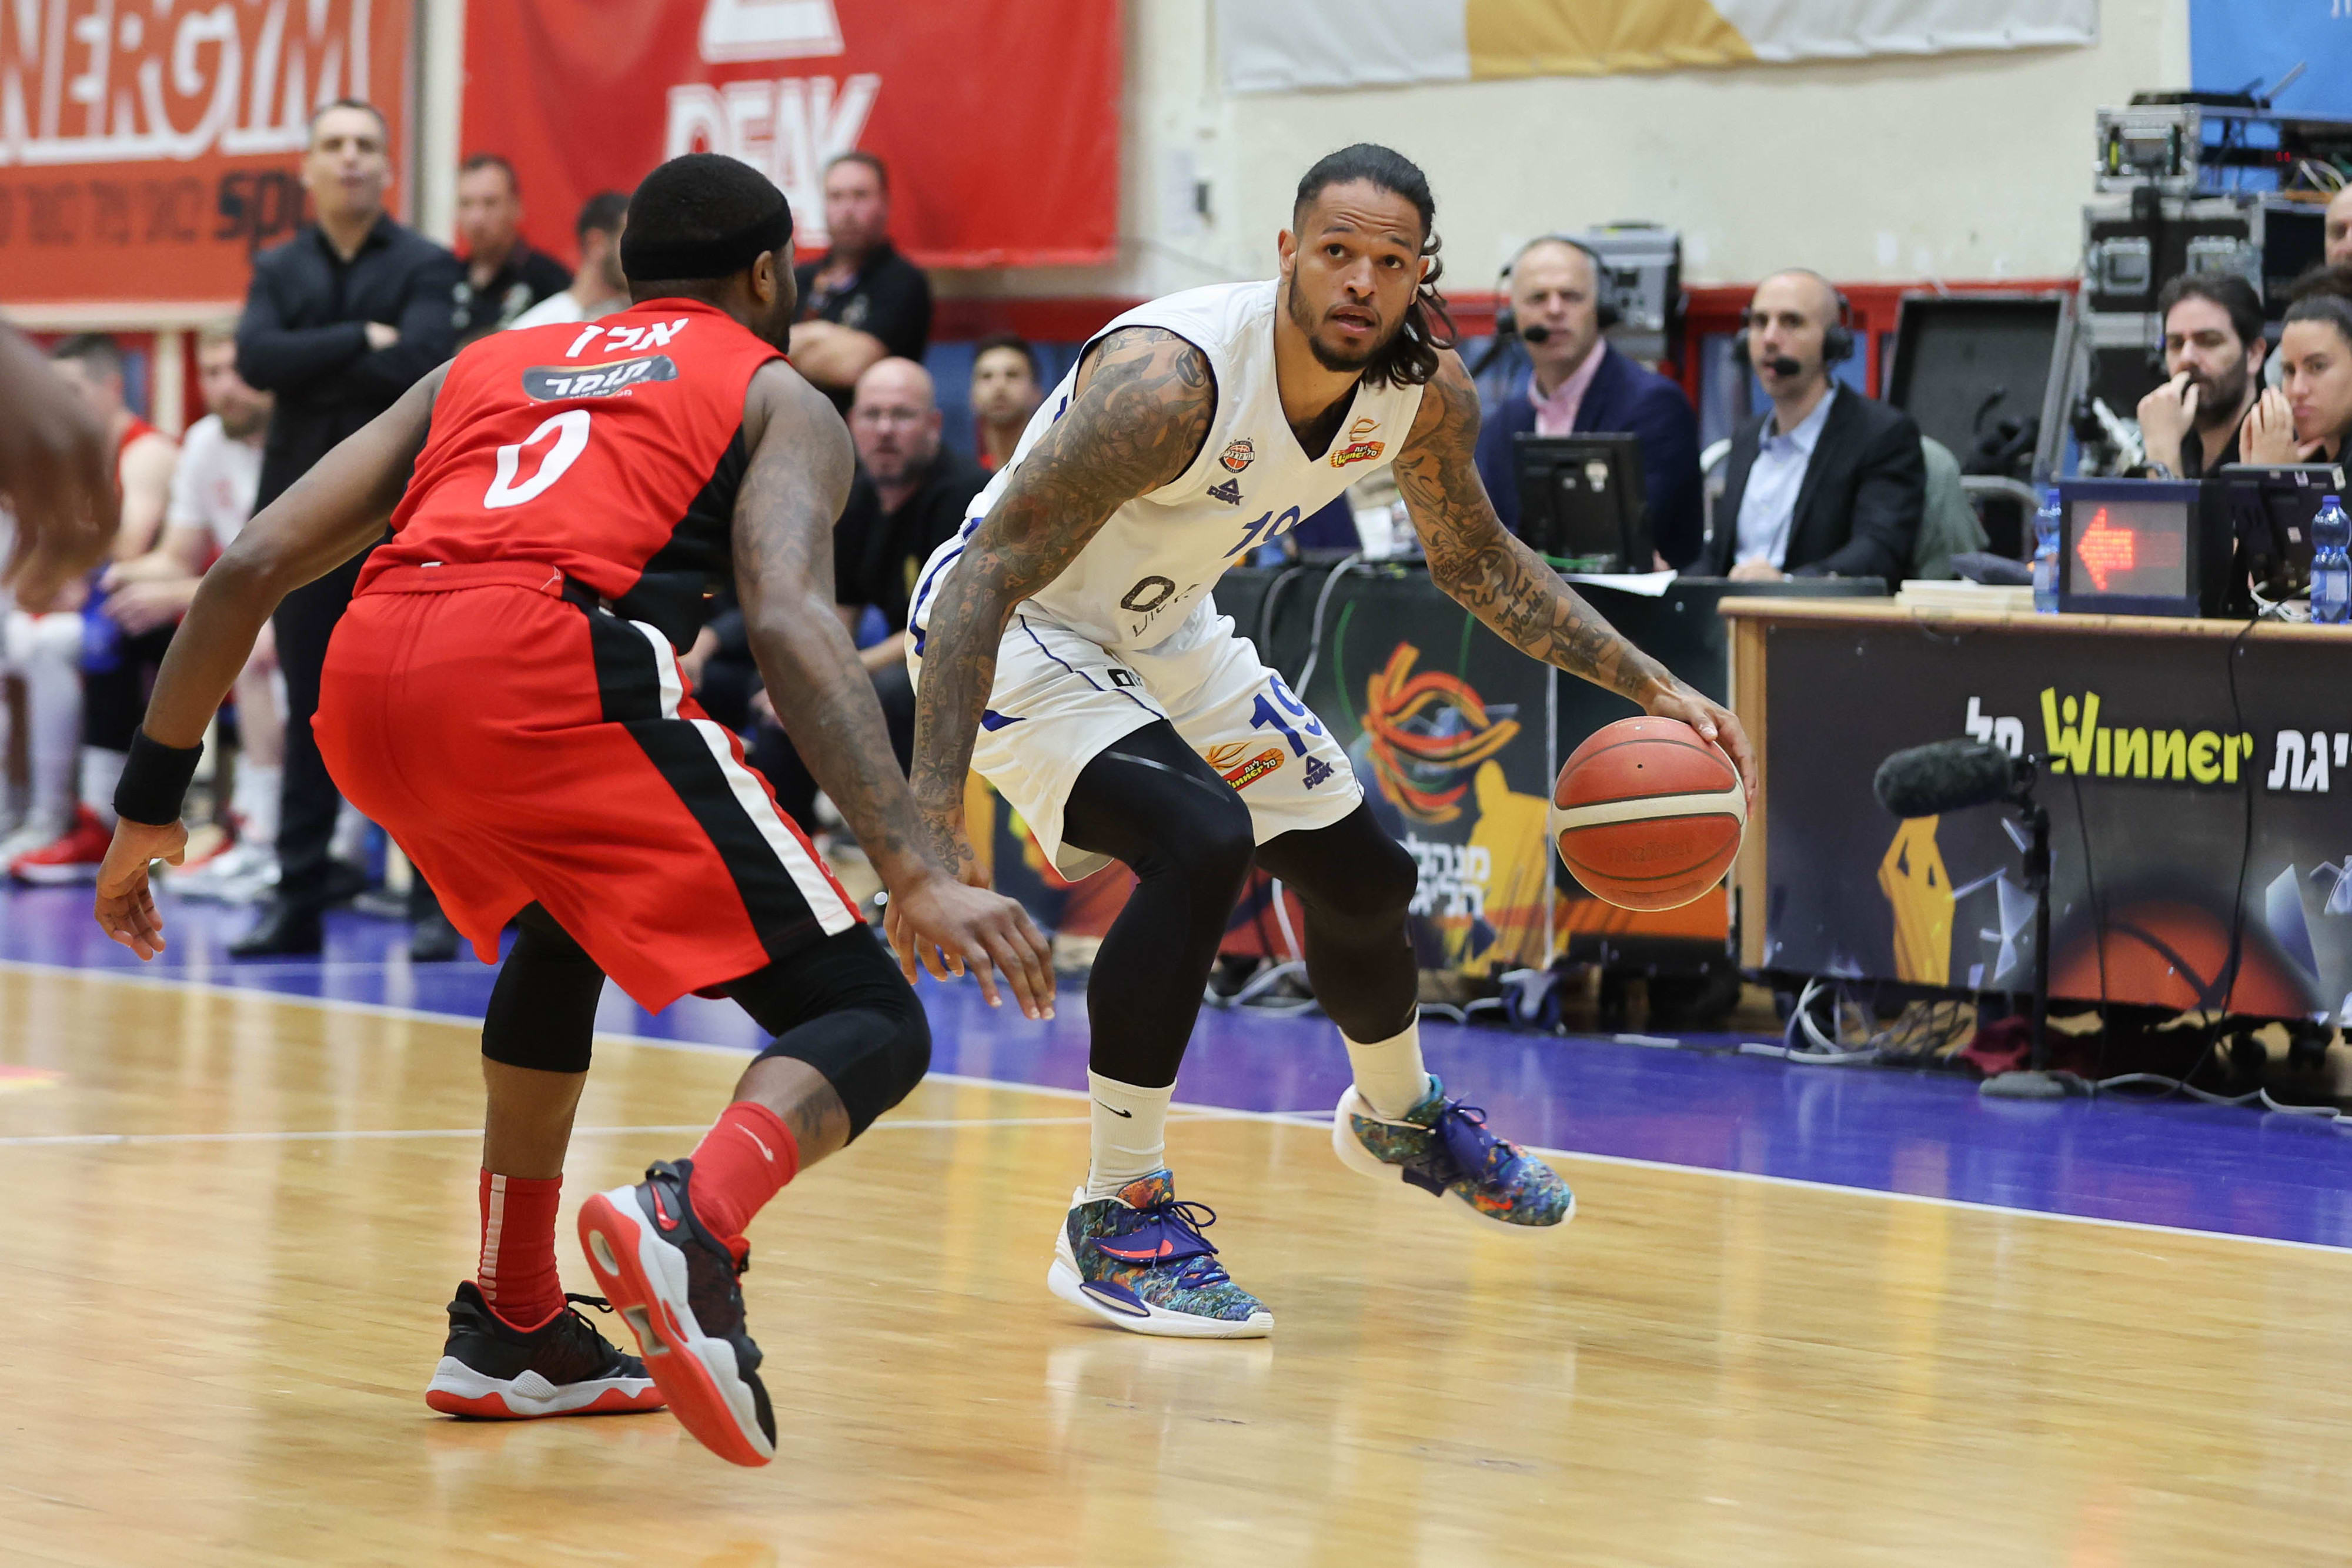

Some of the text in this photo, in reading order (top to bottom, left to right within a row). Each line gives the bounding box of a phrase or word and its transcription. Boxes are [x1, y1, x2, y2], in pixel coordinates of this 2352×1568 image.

[565, 318, 689, 357] אלן
[483, 409, 591, 509] 0
[1249, 675, 1322, 758] 19
[2040, 686, 2253, 784] Winner
[1262, 758, 1277, 768] סל
[2267, 729, 2352, 793] יגת
[1395, 831, 1491, 883] מנהל
